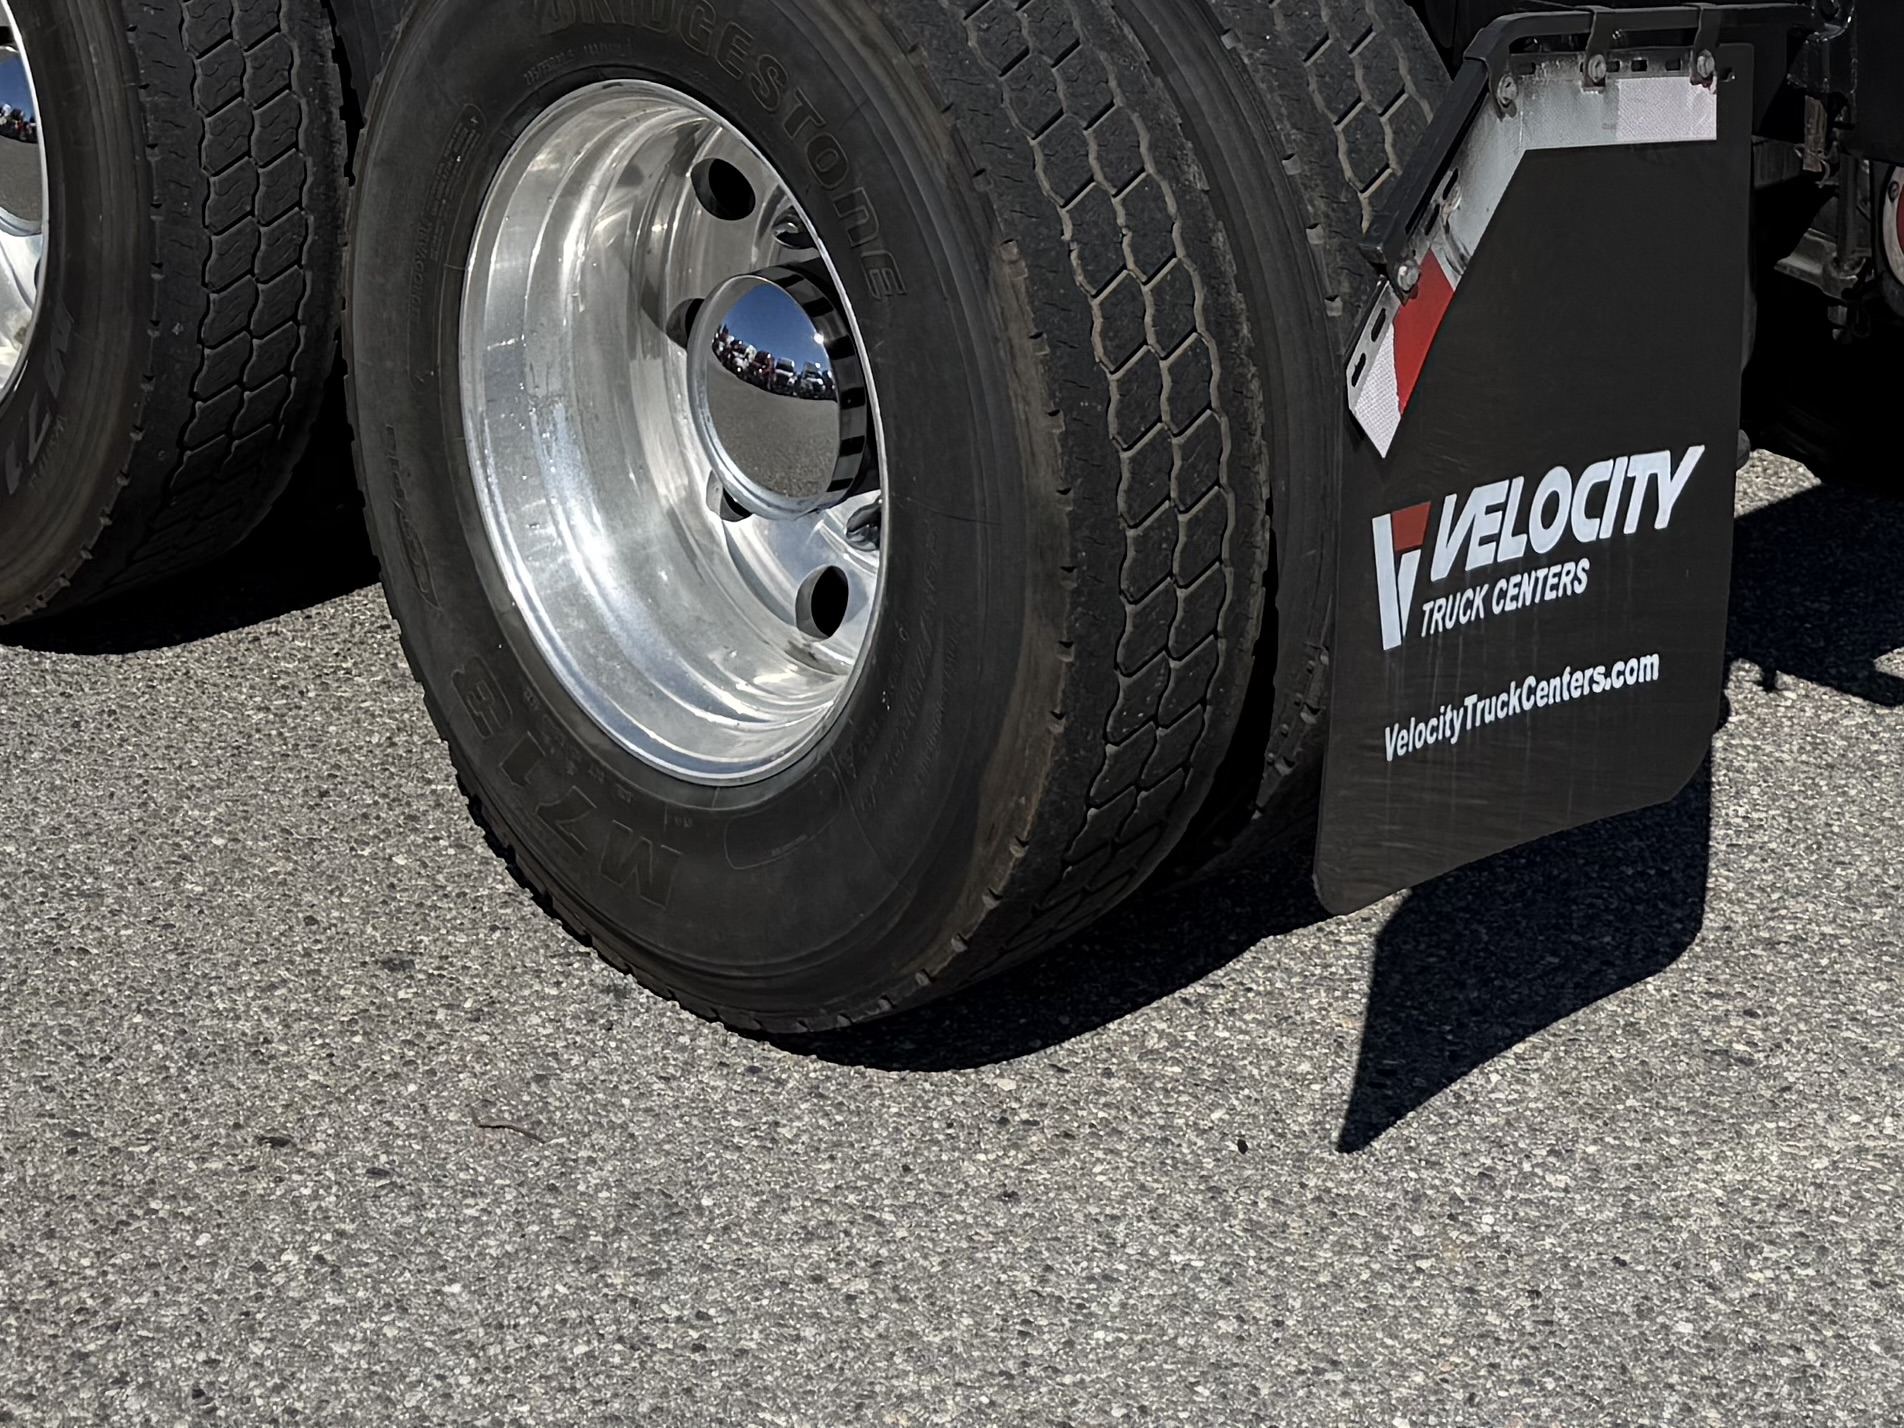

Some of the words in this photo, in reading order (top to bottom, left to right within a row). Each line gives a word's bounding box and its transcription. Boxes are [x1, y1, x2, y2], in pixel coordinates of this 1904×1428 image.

[1431, 445, 1705, 582] VELOCITY
[1422, 583, 1490, 637] TRUCK
[1491, 558, 1590, 615] CENTERS
[1384, 653, 1660, 762] VelocityTruckCenters.com
